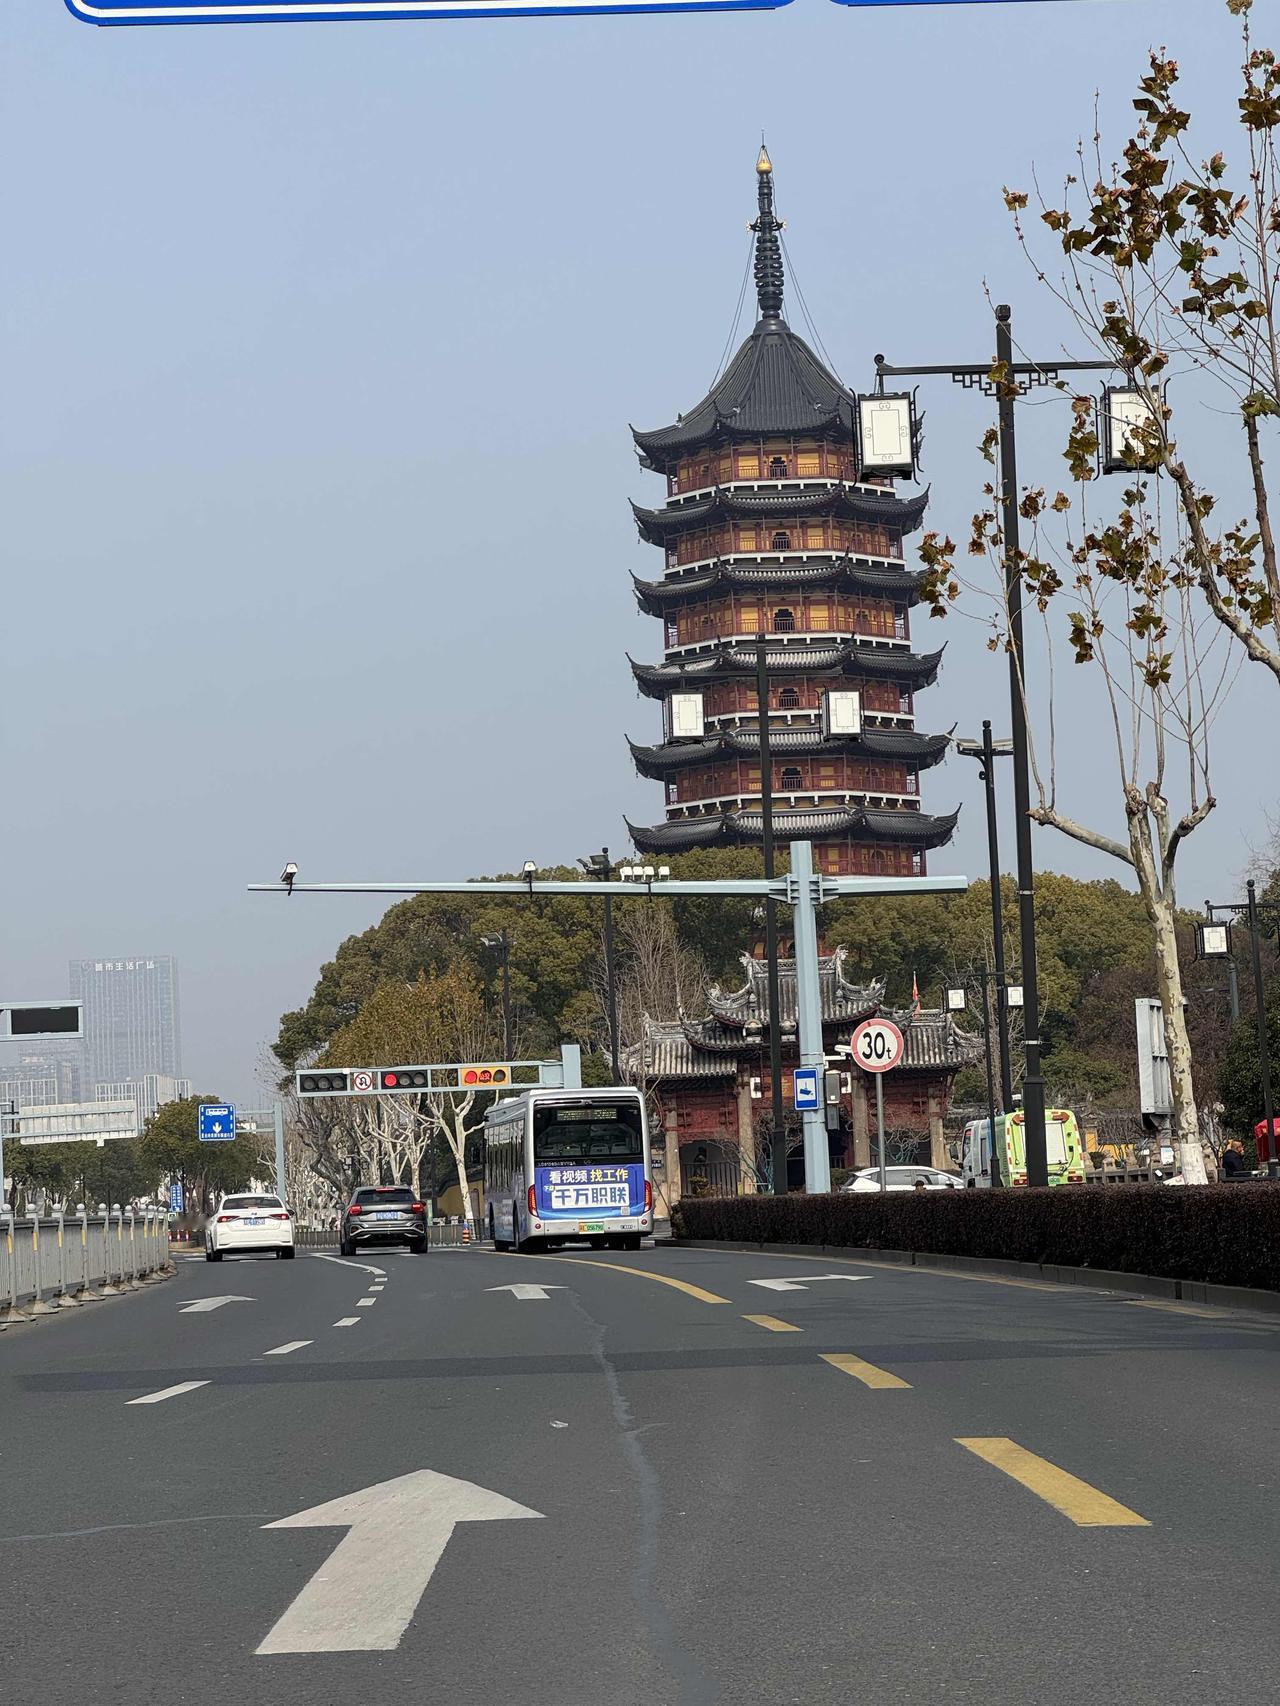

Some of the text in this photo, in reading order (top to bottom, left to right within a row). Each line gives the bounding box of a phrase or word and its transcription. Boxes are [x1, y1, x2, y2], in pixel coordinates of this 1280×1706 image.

[549, 1168, 629, 1184] 看视频 找工作
[554, 1186, 627, 1206] 千万职联
